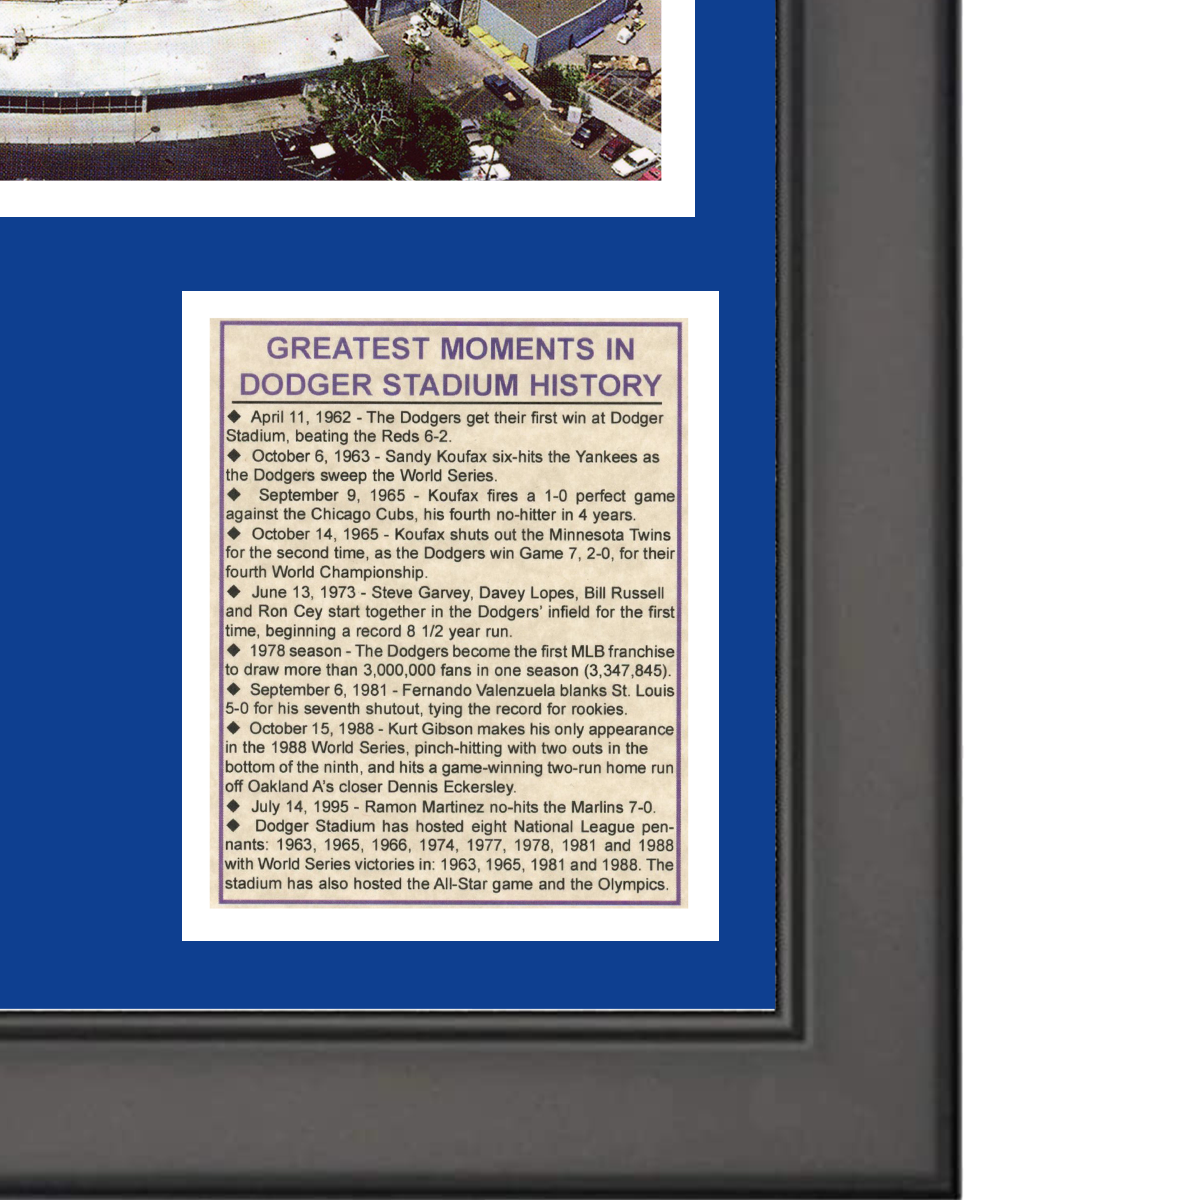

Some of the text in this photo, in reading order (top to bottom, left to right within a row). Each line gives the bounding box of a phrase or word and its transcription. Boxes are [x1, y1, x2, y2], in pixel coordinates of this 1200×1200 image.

[266, 336, 634, 360] GREATEST MOMENTS IN
[240, 372, 662, 396] DODGER STADIUM HISTORY
[250, 409, 664, 427] April 11, 1962 The Dodgers get their first win at Dodger
[225, 428, 451, 445] Stadium, beating the Reds 6-2.
[251, 448, 659, 466] October 6, 1963 Sandy Koufax six-hits the Yankees as
[258, 487, 675, 505] September 9, 1965 Koufax fires a 1-0 perfect game
[225, 506, 635, 524] against the Chicago Cubs, his fourth no-hitter in 4 years.
[225, 545, 675, 562] for the second time, as the Dodgers win Game 7, 2-0, for their
[251, 585, 664, 602] June 13, 1973 Steve Garvey, Davey Lopes, Bill Russell
[225, 604, 252, 617] and
[258, 604, 287, 617] Ron
[293, 604, 322, 620] Cey
[328, 604, 360, 617] start
[365, 604, 426, 621] together
[431, 604, 443, 617] in
[448, 604, 471, 618] the
[548, 604, 589, 618] infield
[595, 604, 615, 618] for
[619, 604, 643, 618] the
[647, 604, 675, 618] first
[250, 643, 675, 660] 1978 season The Dodgers become the first MLB franchise
[250, 682, 674, 698] September 6, 1981 Fernando Valenzuela blanks St. Louis
[249, 720, 674, 738] October 15, 1988 Kurt Gibson makes his only appearance
[255, 818, 674, 836] Dodger Stadium has hosted eight National League pen-
[225, 837, 673, 853] nants: 1963, 1965, 1966, 1974, 1977, 1978, 1981 and 1988
[225, 876, 668, 893] stadium has also hosted the All-Star game and the Olympics.
